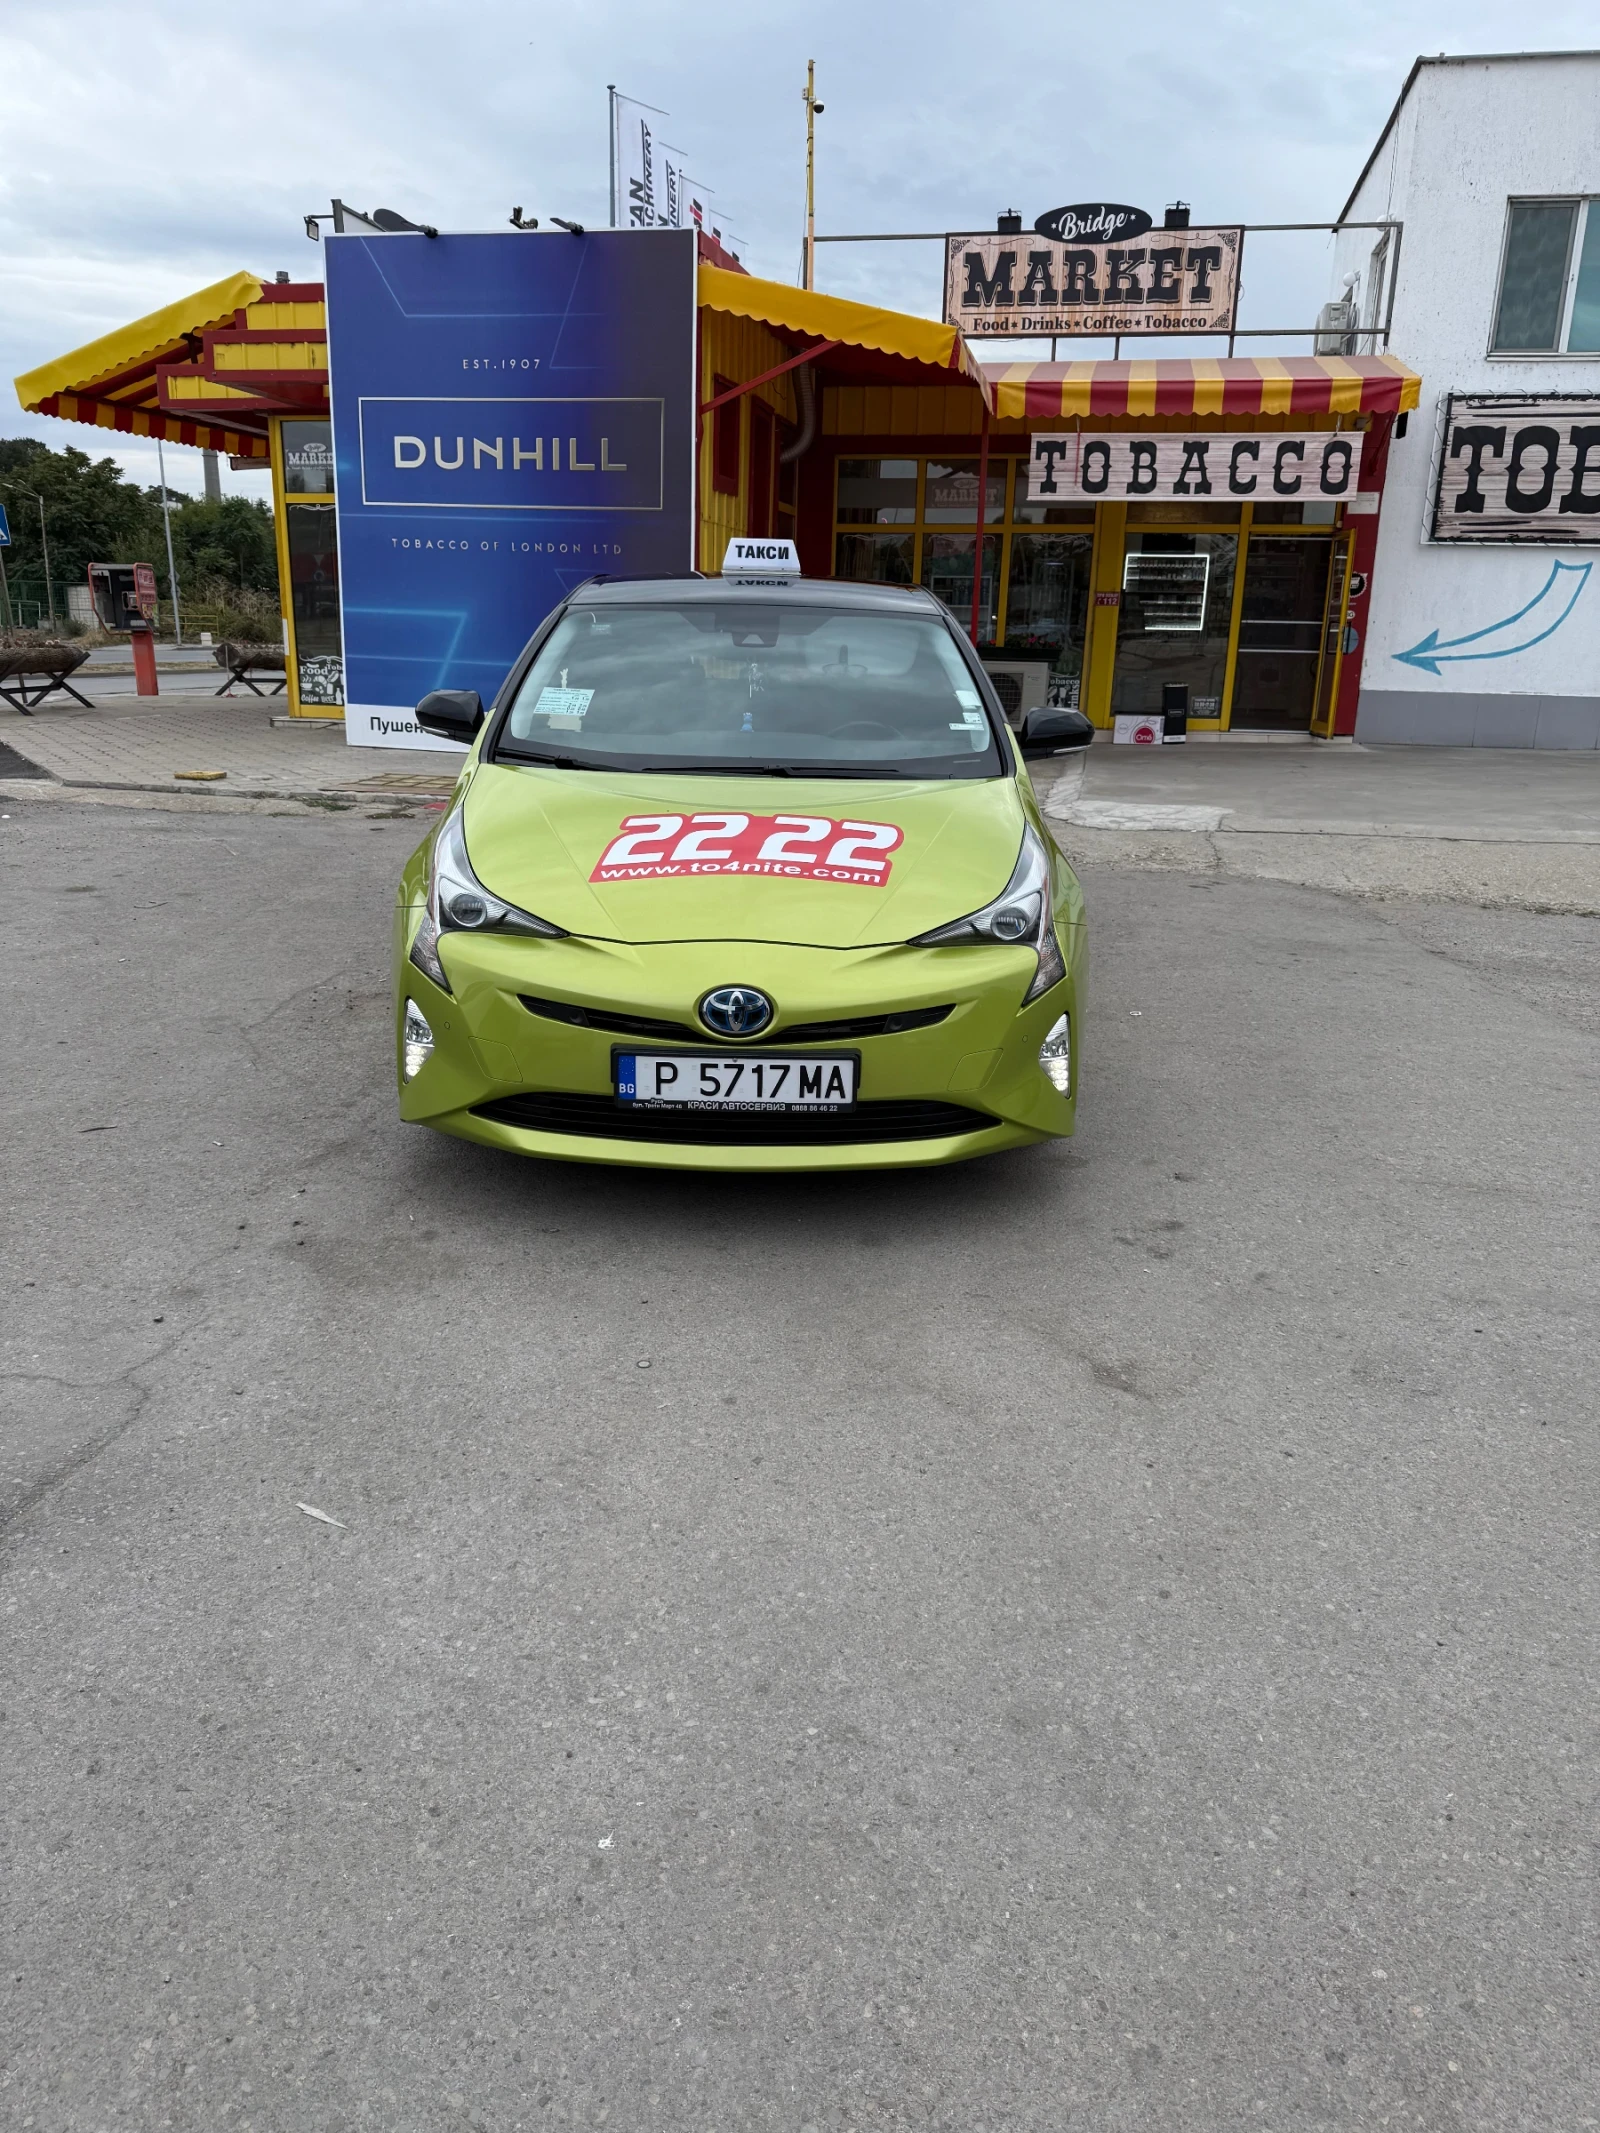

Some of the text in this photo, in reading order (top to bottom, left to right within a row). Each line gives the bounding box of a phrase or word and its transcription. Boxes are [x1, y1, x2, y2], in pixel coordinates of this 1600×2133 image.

[644, 123, 655, 227] CHINERY
[630, 177, 644, 227] AN
[1058, 206, 1129, 240] Bridge
[962, 246, 1222, 308] MARKET
[973, 314, 1207, 331] Food Drinks Coffee Tobacco
[394, 436, 627, 471] DUNHILL
[1035, 440, 1354, 495] TOBACCO
[1451, 425, 1600, 514] TOB
[934, 488, 997, 502] MARKT
[391, 538, 622, 555] TOBACCO OF LONDON LTD
[735, 545, 789, 560] ТАКСИ
[299, 665, 328, 675] Food
[601, 815, 898, 870] 22 22
[600, 860, 881, 883] www.to4nite.com
[618, 1083, 635, 1094] BG
[687, 1101, 786, 1111] КРАСИ АВТОСЕРВИЗ
